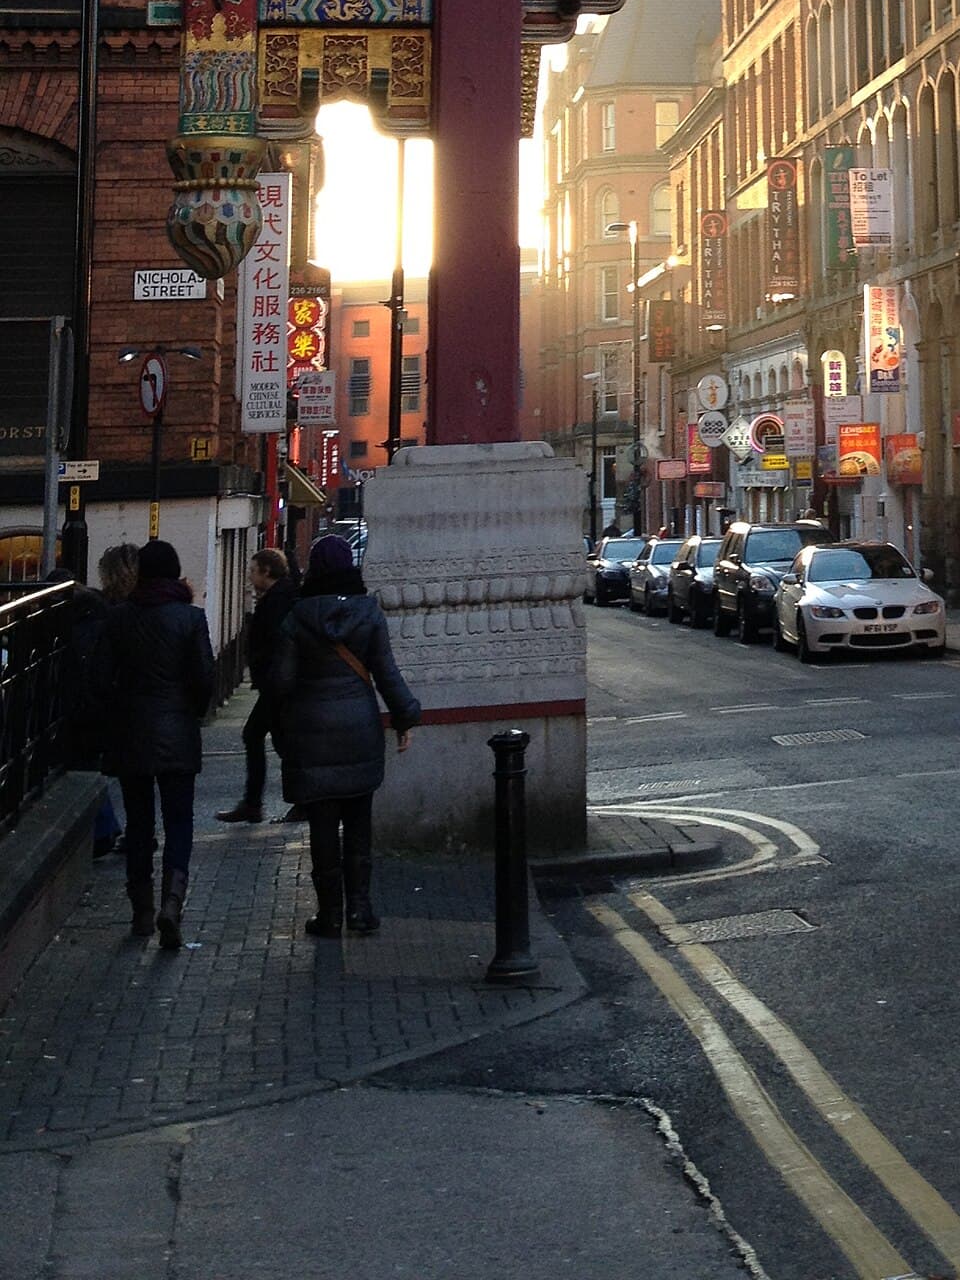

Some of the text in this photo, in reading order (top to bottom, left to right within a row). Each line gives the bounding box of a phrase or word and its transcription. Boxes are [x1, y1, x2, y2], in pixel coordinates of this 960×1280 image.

[853, 171, 888, 181] To Let
[771, 191, 782, 274] TRY THAI
[142, 285, 195, 297] STREET
[250, 382, 280, 390] MODERN
[249, 391, 279, 401] CHINESE
[194, 439, 209, 456] H
